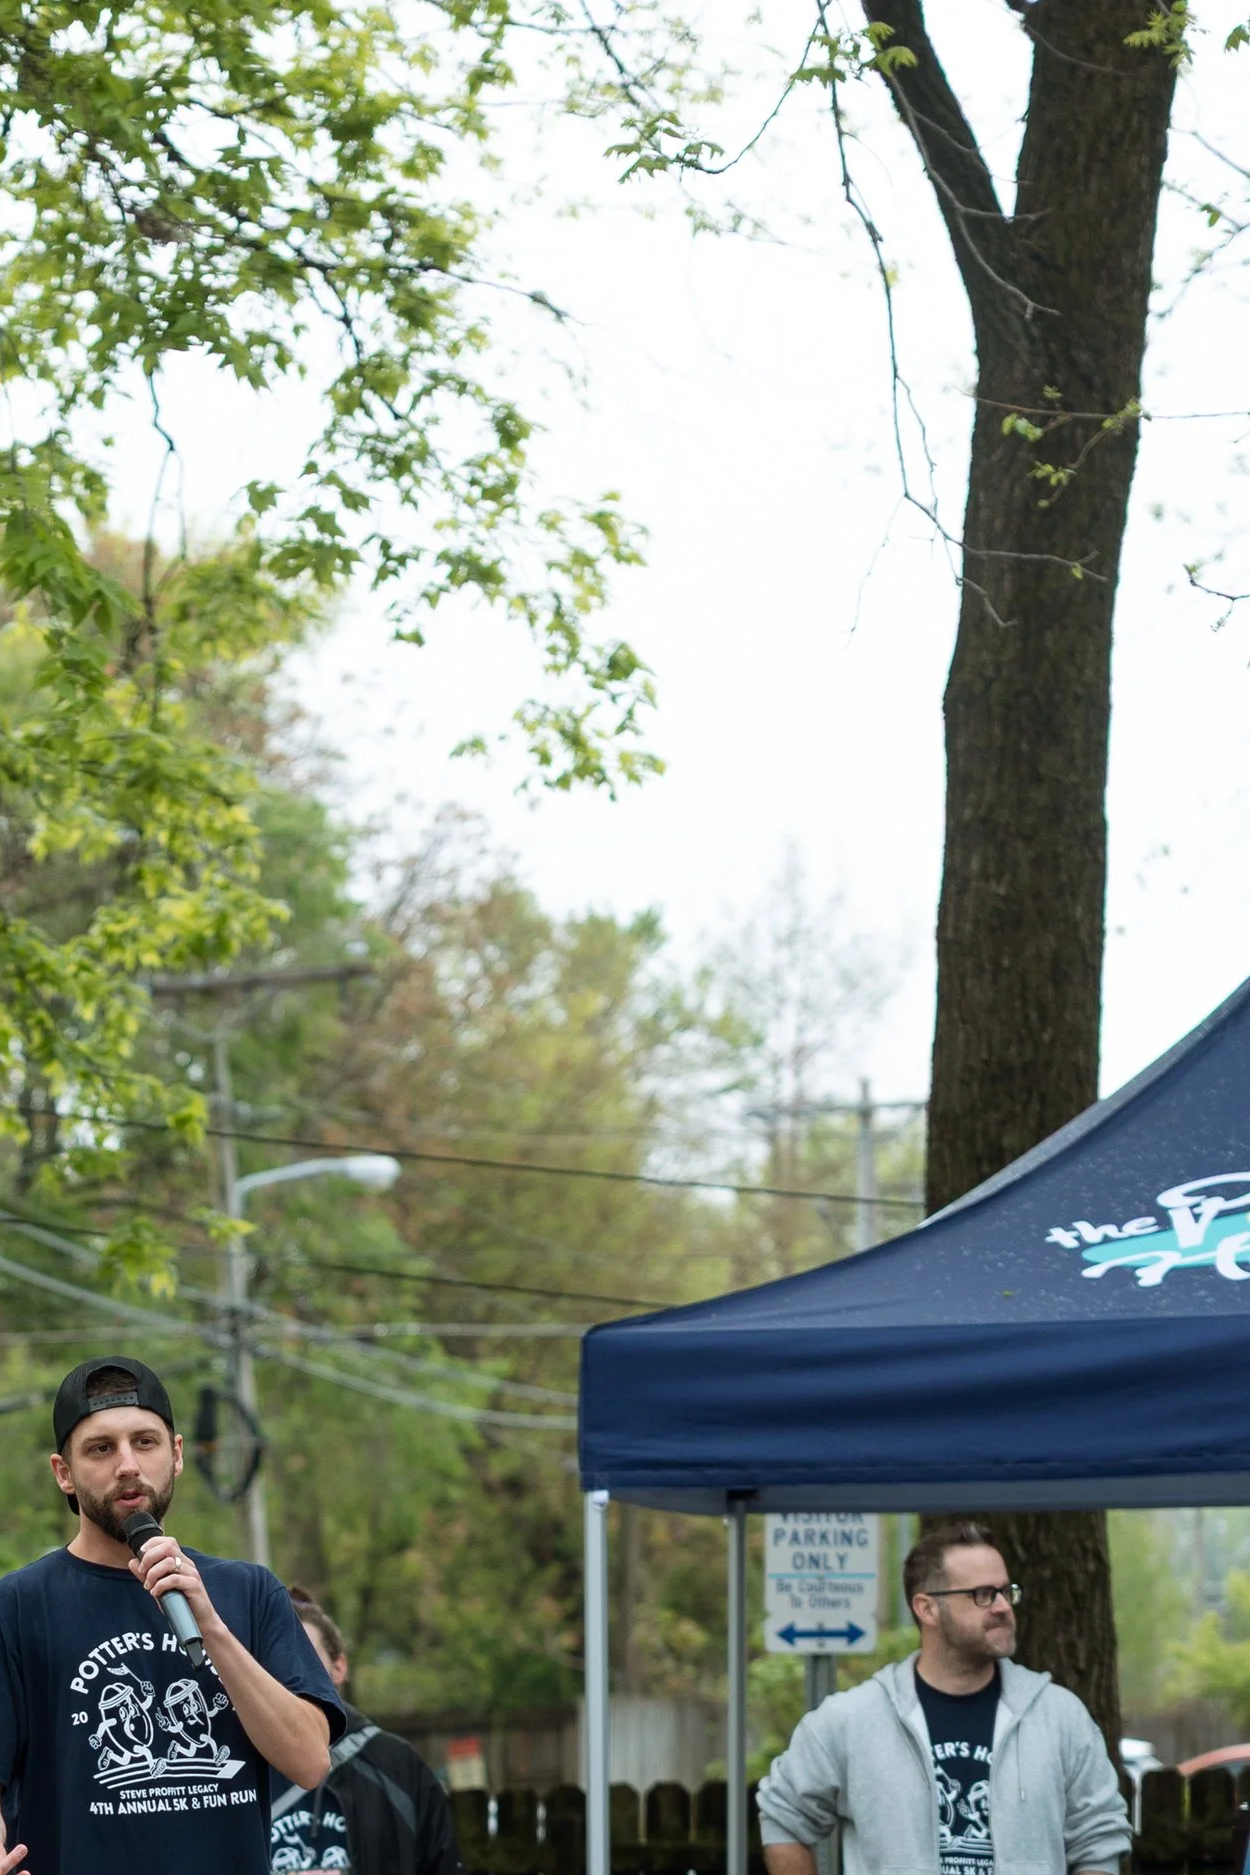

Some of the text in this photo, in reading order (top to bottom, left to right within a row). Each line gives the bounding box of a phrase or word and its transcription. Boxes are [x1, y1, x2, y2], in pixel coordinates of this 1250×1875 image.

[1045, 1216, 1160, 1249] the
[780, 1512, 864, 1525] VISITOR
[773, 1528, 869, 1548] PARKING
[792, 1551, 848, 1571] ONLY
[775, 1579, 793, 1593] Be
[789, 1595, 851, 1609] To Others
[70, 1632, 154, 1694] POTTER'S
[71, 1711, 89, 1726] 20
[120, 1789, 148, 1799] STEVE
[188, 1783, 219, 1795] LEGACY
[89, 1789, 258, 1815] 4TH ANNUAL 5K & FUN RUN
[976, 1858, 993, 1866] LEGA
